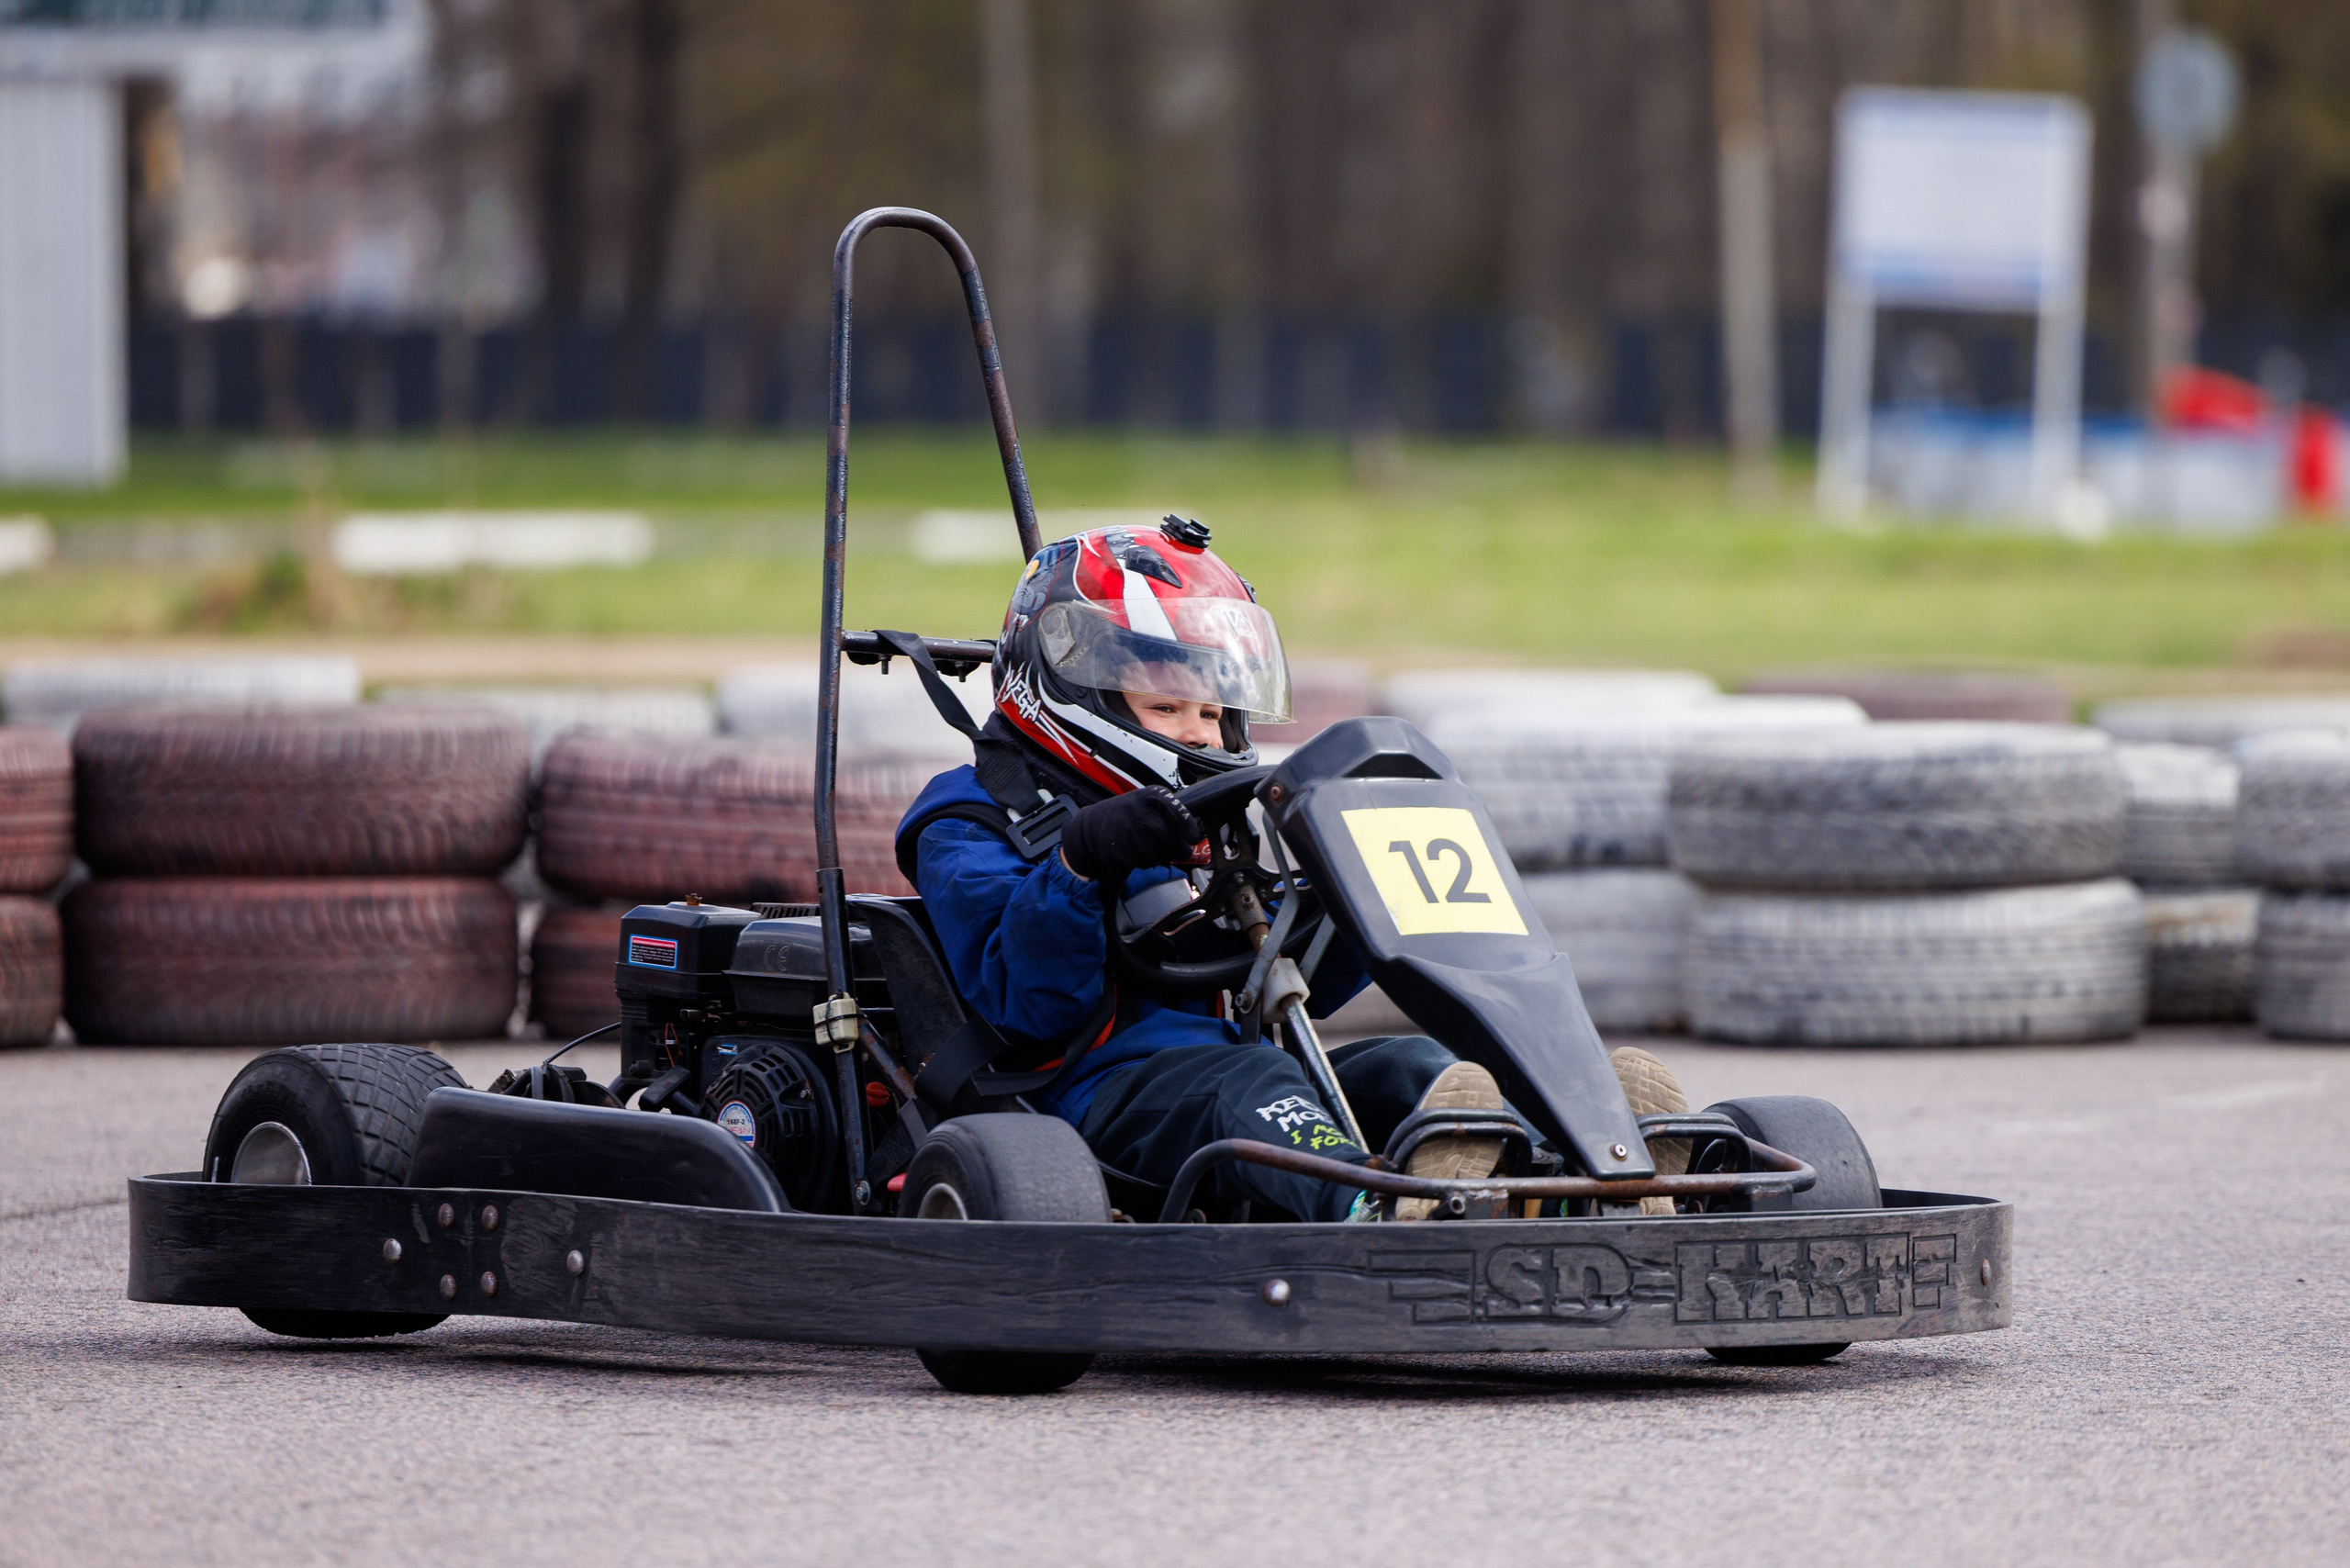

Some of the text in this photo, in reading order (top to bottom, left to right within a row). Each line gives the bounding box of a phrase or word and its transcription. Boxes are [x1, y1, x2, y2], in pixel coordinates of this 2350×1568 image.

[996, 663, 1042, 722] VEGA
[1387, 837, 1493, 904] 12
[764, 944, 789, 971] CE
[1675, 1233, 1908, 1322] KART
